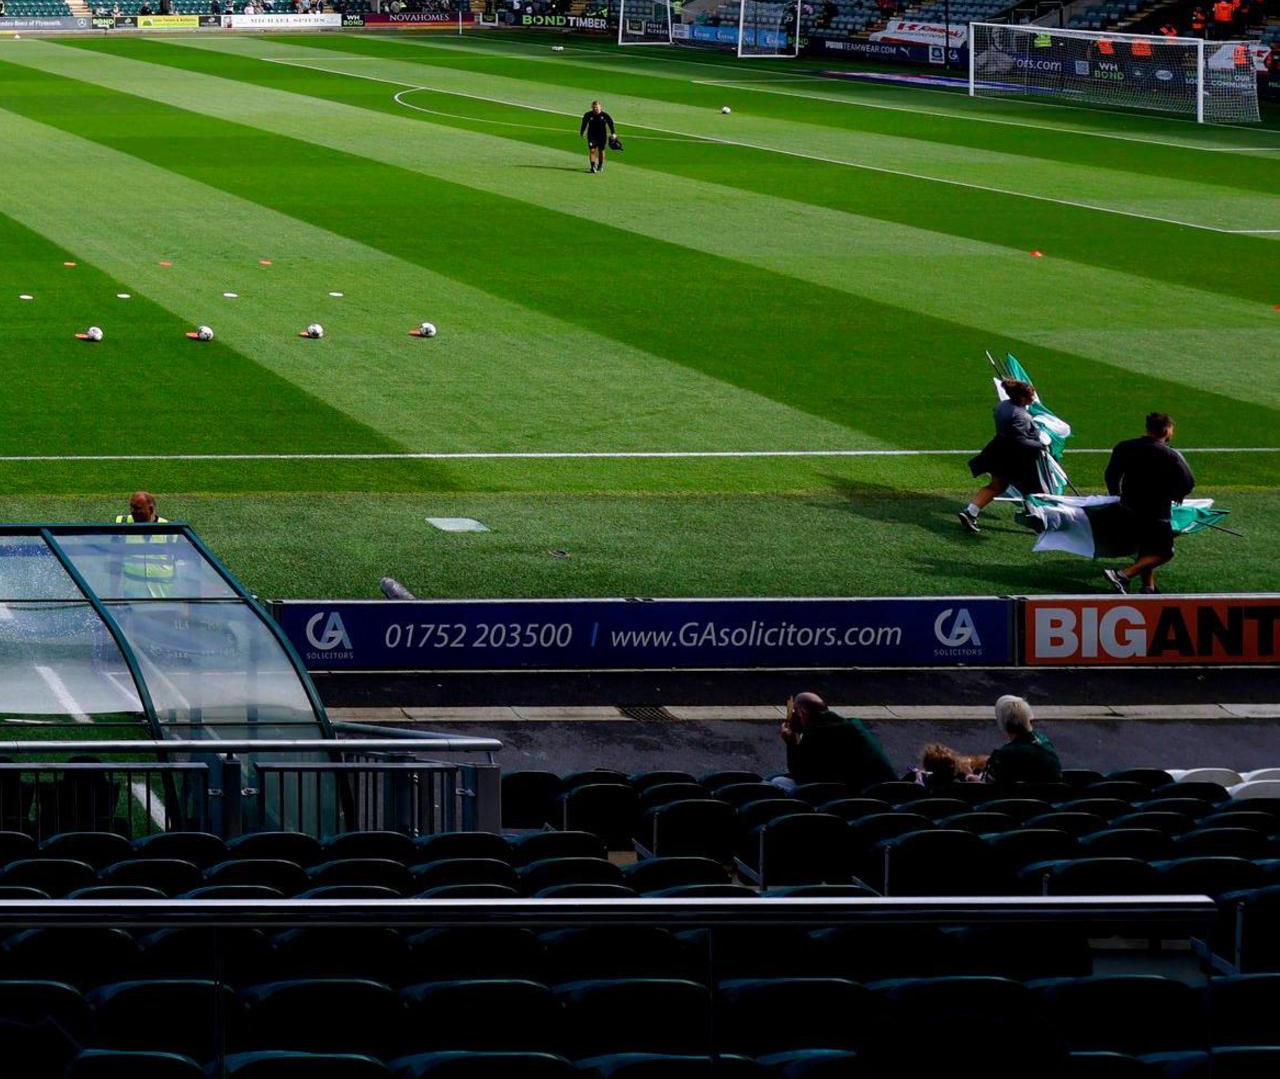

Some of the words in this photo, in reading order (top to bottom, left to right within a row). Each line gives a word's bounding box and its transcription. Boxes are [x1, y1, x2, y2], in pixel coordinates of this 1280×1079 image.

[93, 18, 115, 26] BOND
[389, 14, 450, 22] NOVAHOMES
[522, 14, 567, 27] BOND
[567, 16, 607, 29] TIMBER
[1098, 62, 1119, 71] WH
[1094, 70, 1125, 81] BOND
[384, 623, 467, 648] 01752
[472, 623, 574, 648] 203500
[610, 621, 903, 648] www.GAsolicitors.com
[305, 651, 354, 660] SOLICITORS
[933, 648, 984, 658] SOLICITORS
